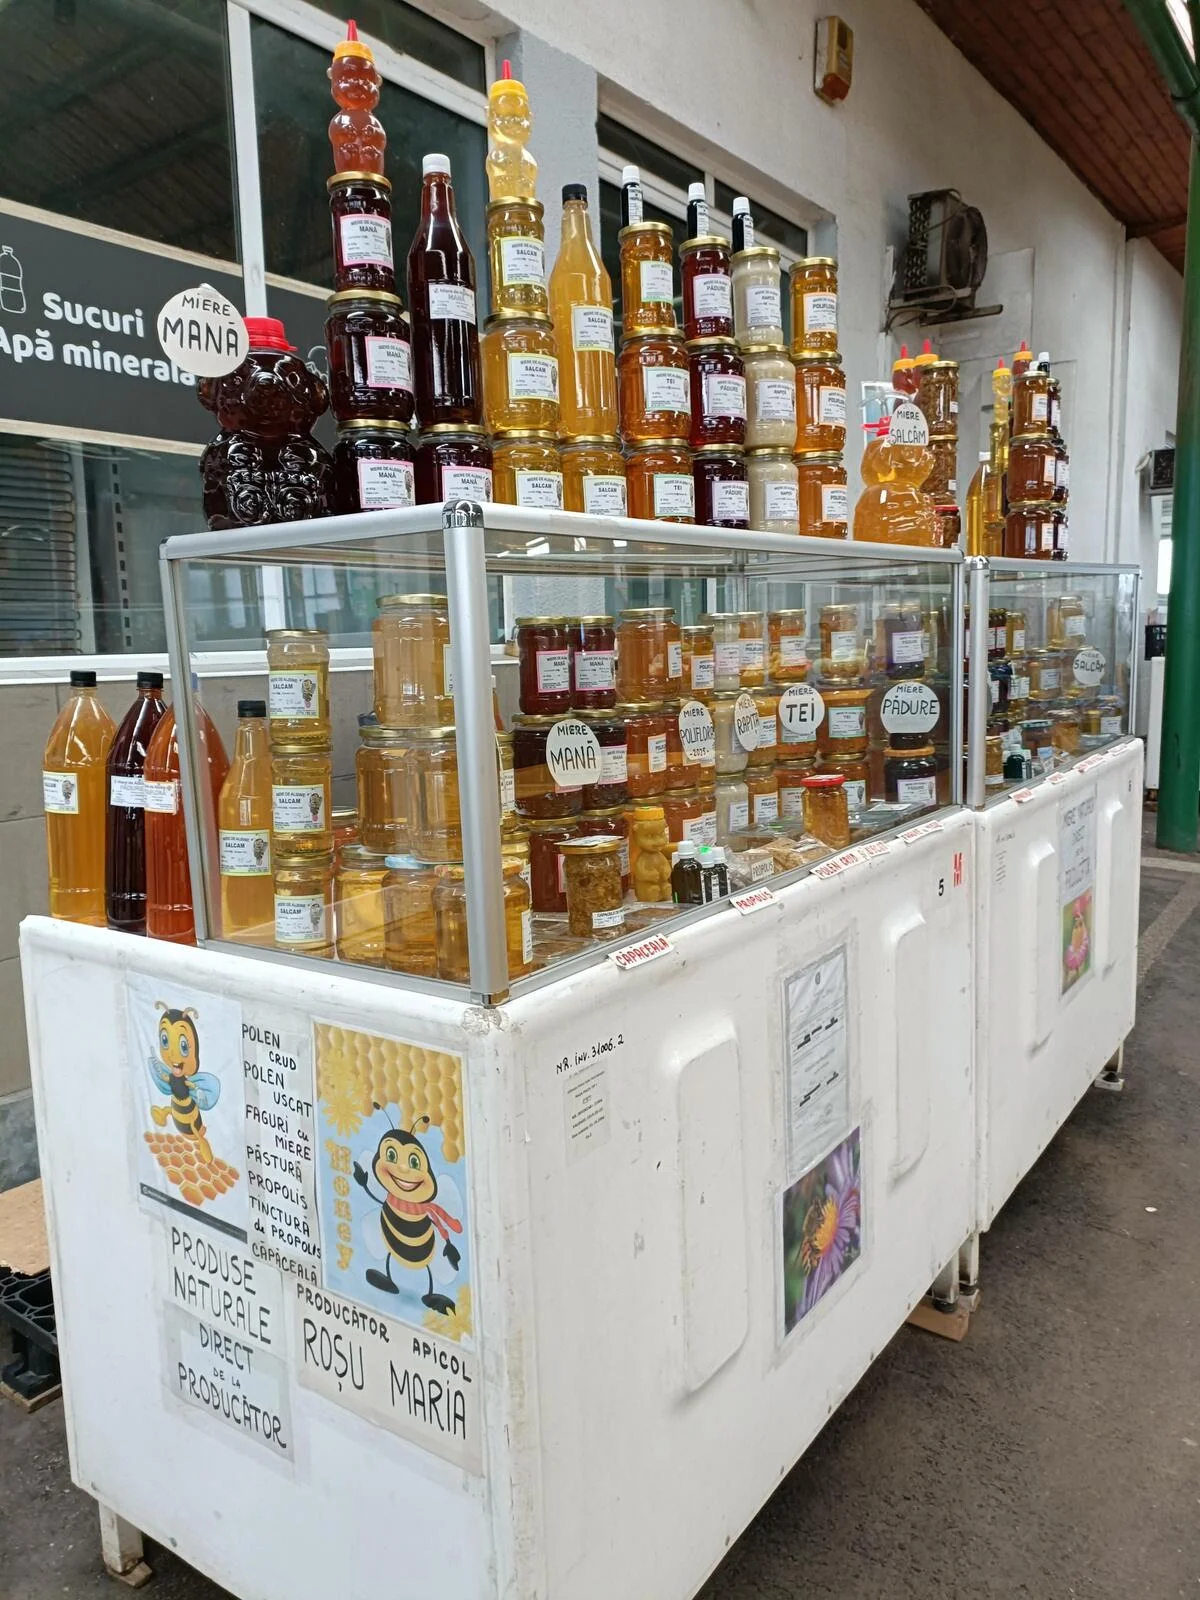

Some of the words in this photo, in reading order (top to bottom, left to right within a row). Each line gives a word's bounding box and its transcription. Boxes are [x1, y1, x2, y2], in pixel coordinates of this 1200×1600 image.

[42, 292, 145, 338] Sucuri
[181, 293, 231, 316] MIERE
[0, 325, 54, 363] Apă
[163, 317, 239, 357] MANĂ
[897, 410, 920, 421] MIERE
[891, 425, 926, 445] SALCÂM
[788, 687, 814, 697] MIERE
[896, 685, 923, 694] MIERE
[683, 708, 705, 718] MIERE
[786, 698, 815, 724] TEI
[882, 695, 938, 716] PĂDURE
[557, 724, 589, 737] MIERE
[550, 740, 597, 774] MANĂ
[815, 860, 841, 878] POLEN
[736, 890, 773, 909] PROPOLIS
[938, 878, 944, 897] 5
[242, 1024, 280, 1049] POLEN
[244, 1061, 285, 1090] POLEN
[269, 1051, 297, 1071] CRUD
[556, 1057, 572, 1075] NR.
[273, 1091, 313, 1118] USCAT
[245, 1104, 289, 1134] FAGURI
[297, 1128, 309, 1142] cu
[275, 1134, 312, 1161] MIERE
[246, 1144, 302, 1184] PĂSTURĂ
[248, 1170, 309, 1211] PROPOLIS
[249, 1195, 310, 1238] TINCTURĂ
[254, 1218, 265, 1235] de
[271, 1224, 322, 1259] PROPOLIS
[171, 1226, 256, 1296] PRODUSE
[252, 1241, 318, 1285] CĂPĂCEALĂ
[173, 1266, 272, 1345] NATURALE
[297, 1283, 390, 1343] PRODUCĂTOR
[200, 1321, 254, 1374] DIRECT
[303, 1318, 365, 1393] ROȘU
[413, 1338, 472, 1384] APICOL
[213, 1367, 225, 1381] DE
[231, 1378, 241, 1389] LA
[178, 1362, 287, 1449] PRODUCĂTOR
[390, 1360, 467, 1441] MARIA
